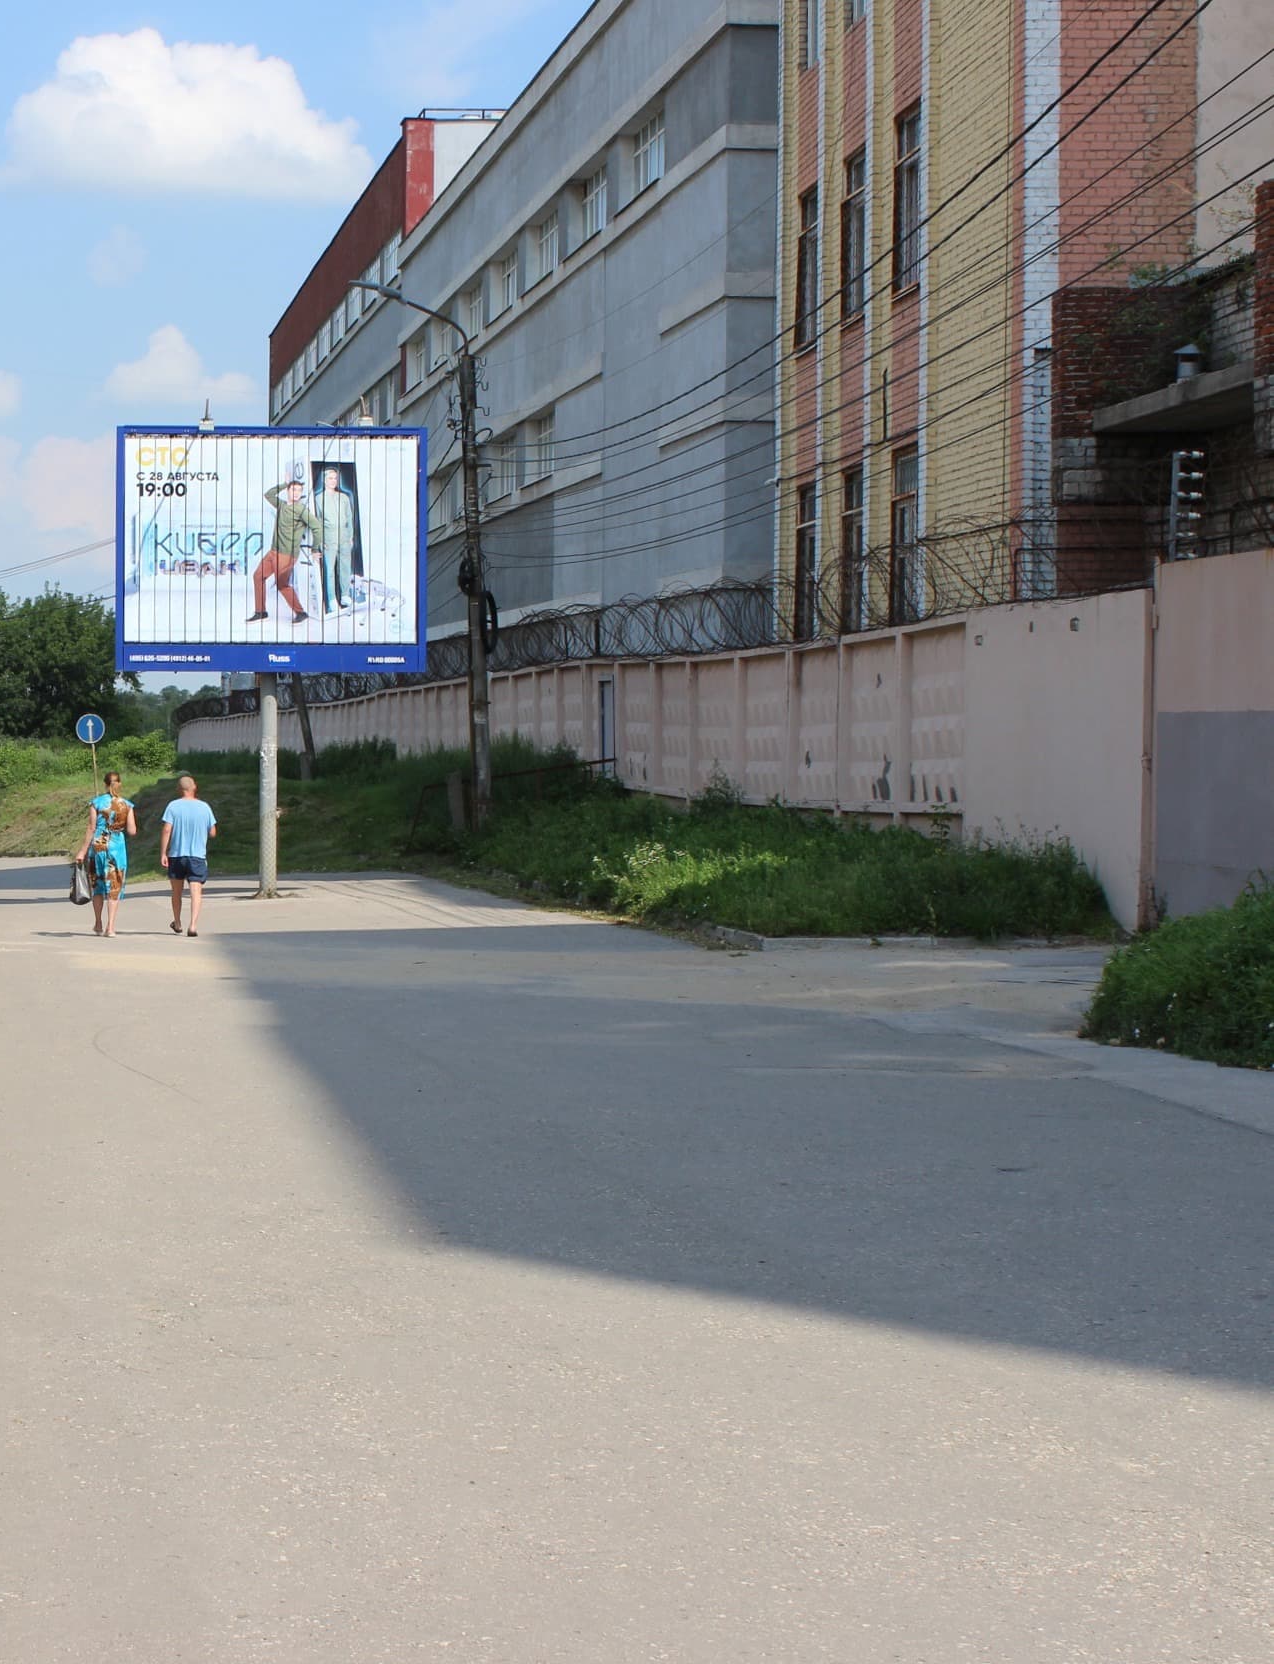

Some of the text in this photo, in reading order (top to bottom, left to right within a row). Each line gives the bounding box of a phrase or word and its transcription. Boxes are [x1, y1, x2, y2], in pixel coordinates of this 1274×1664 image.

[136, 447, 189, 467] СТС
[136, 472, 219, 481] С 28 АВГУСТА
[137, 483, 187, 497] 19:00
[269, 654, 290, 663] Russ
